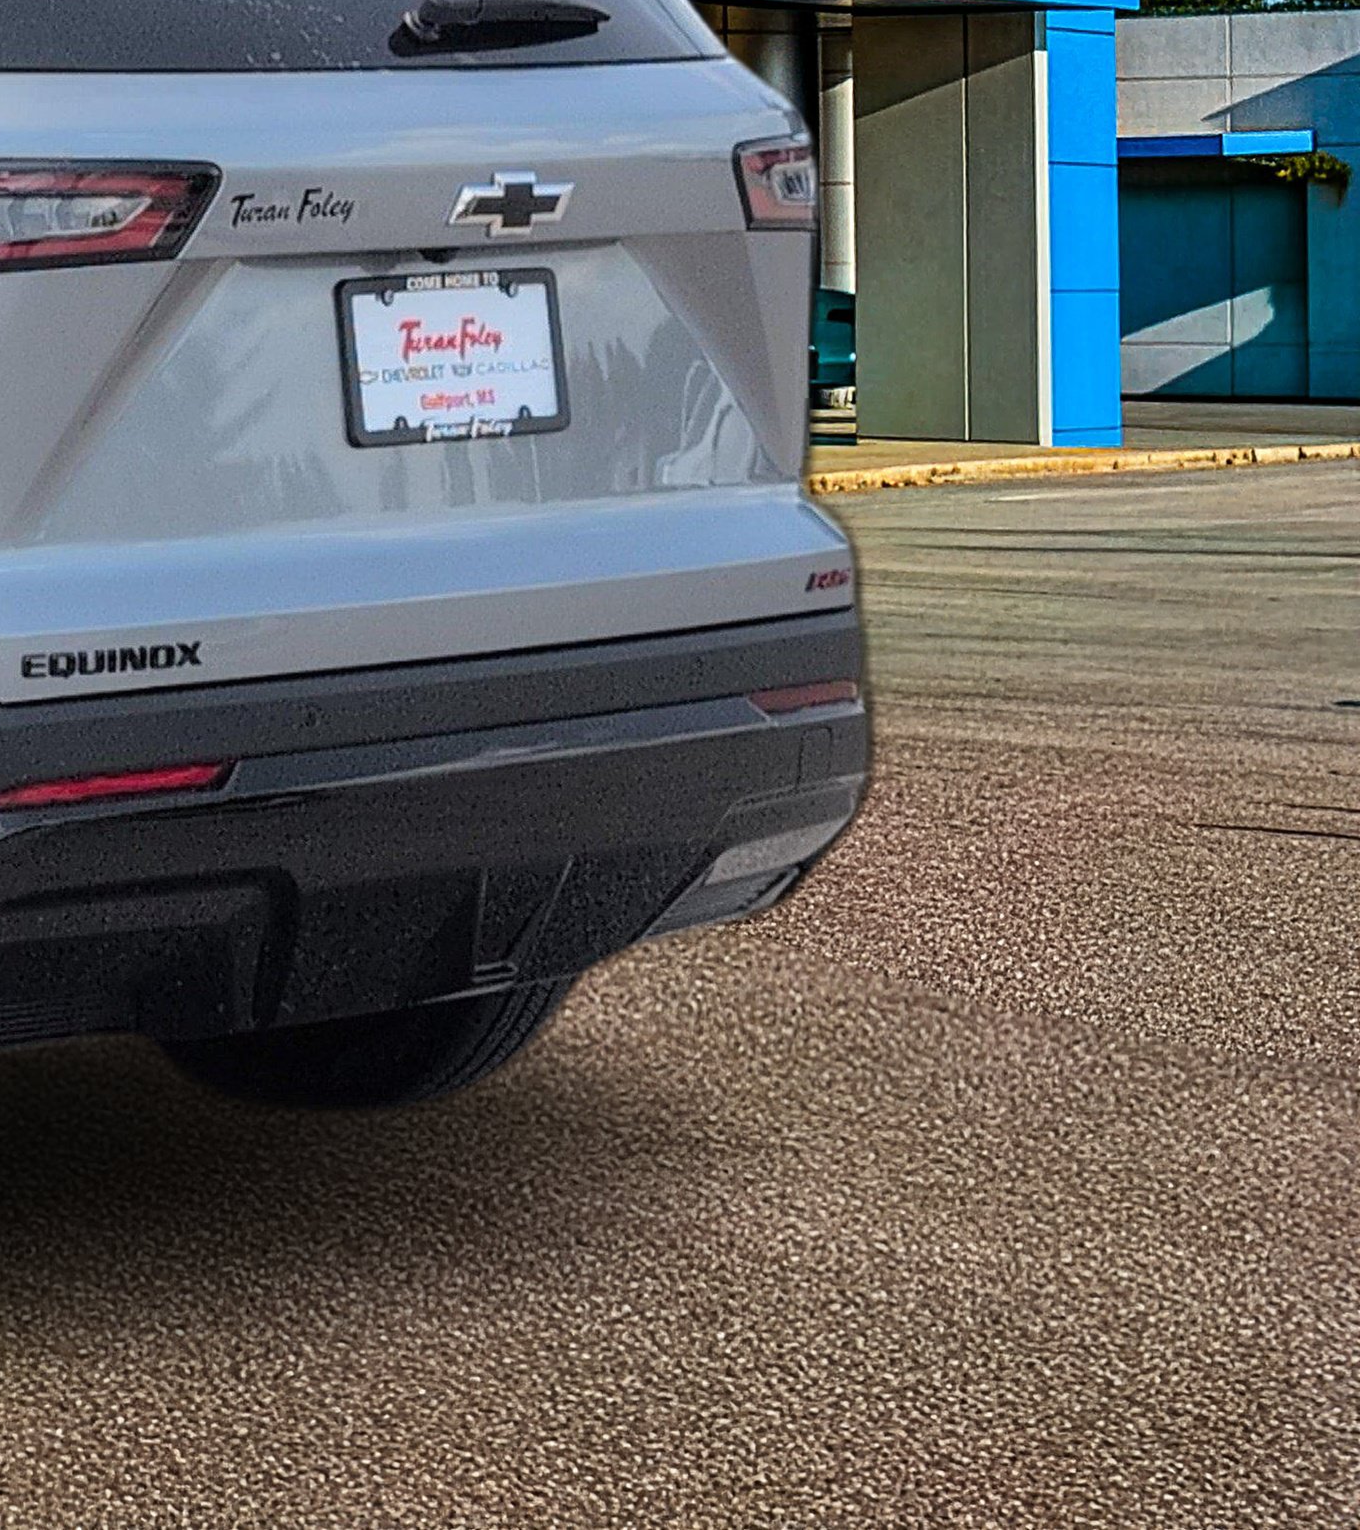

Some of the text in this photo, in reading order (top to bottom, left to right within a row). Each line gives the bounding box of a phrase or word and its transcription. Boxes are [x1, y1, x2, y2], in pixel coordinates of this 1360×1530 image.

[230, 186, 356, 228] Turan Foley
[20, 641, 203, 679] EQUINOX
